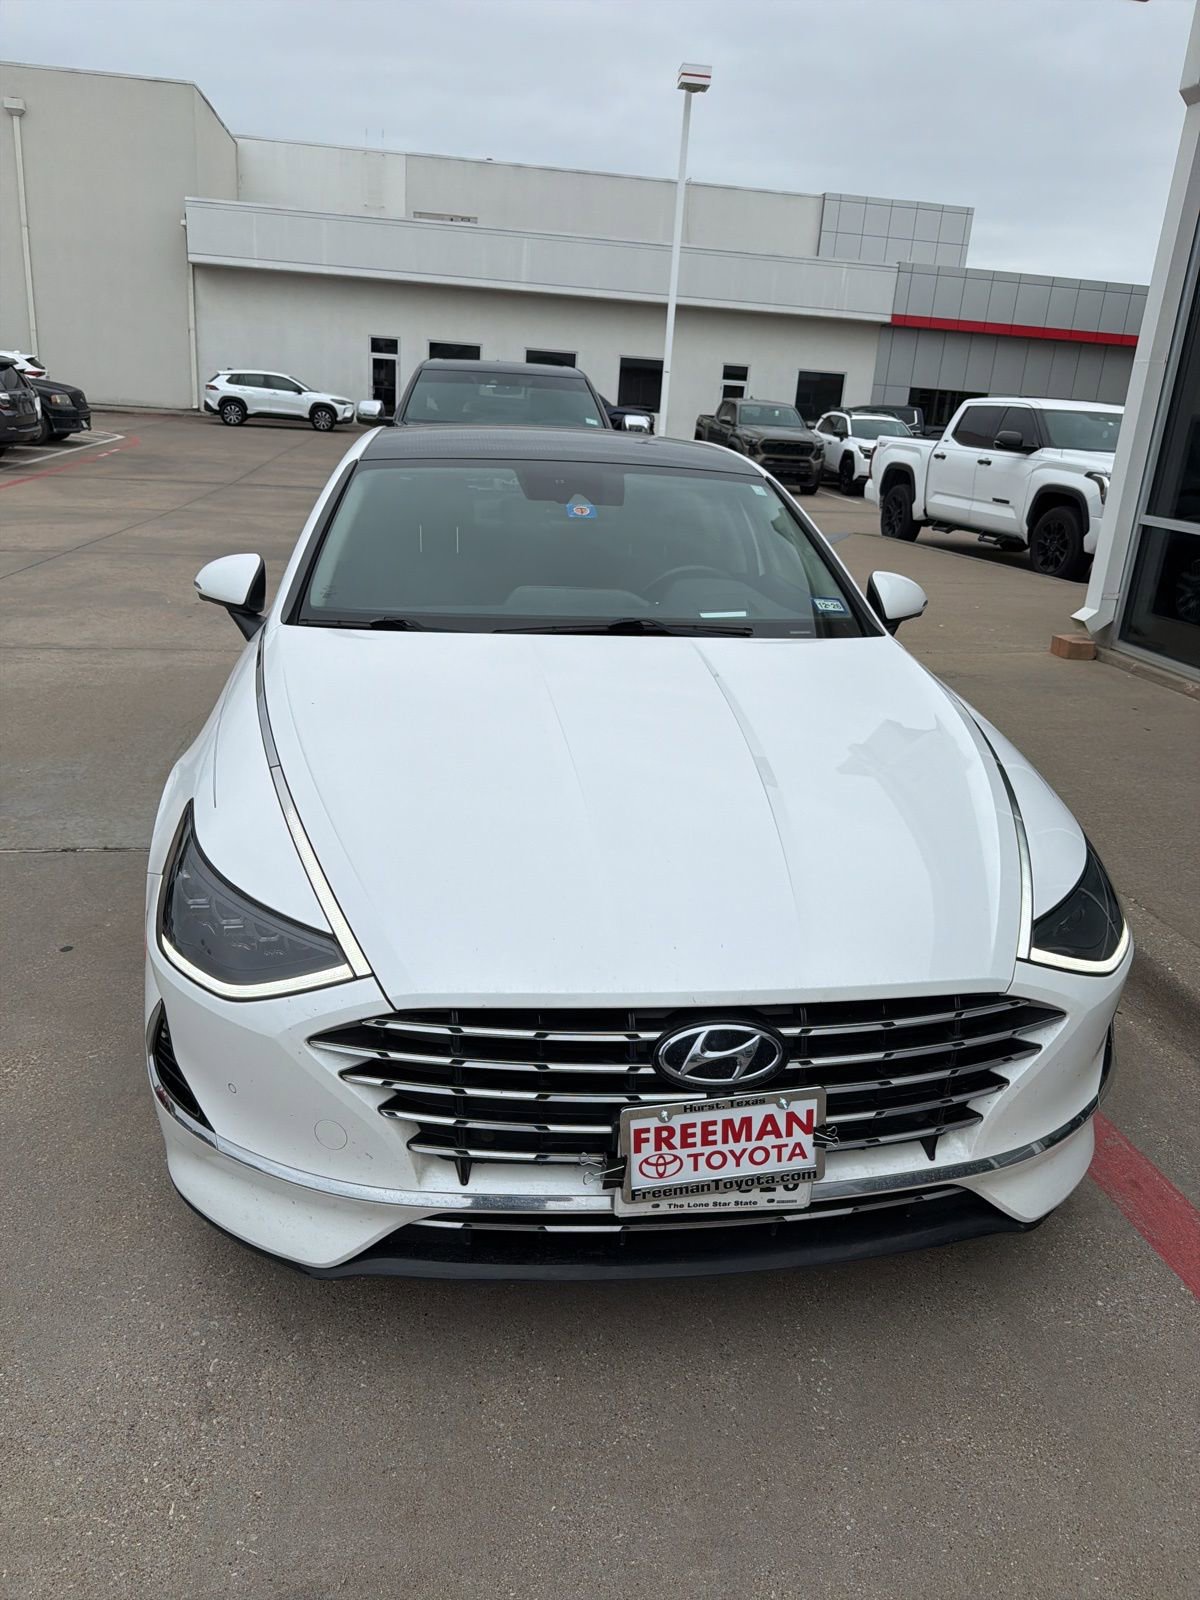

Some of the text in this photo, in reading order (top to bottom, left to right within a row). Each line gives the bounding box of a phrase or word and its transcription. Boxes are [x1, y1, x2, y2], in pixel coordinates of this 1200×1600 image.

[683, 1097, 766, 1113] Hurst, Texas
[633, 1109, 814, 1154] FREEMAN
[687, 1142, 808, 1172] TOYOTA
[631, 1170, 817, 1201] FreemanToyota.com
